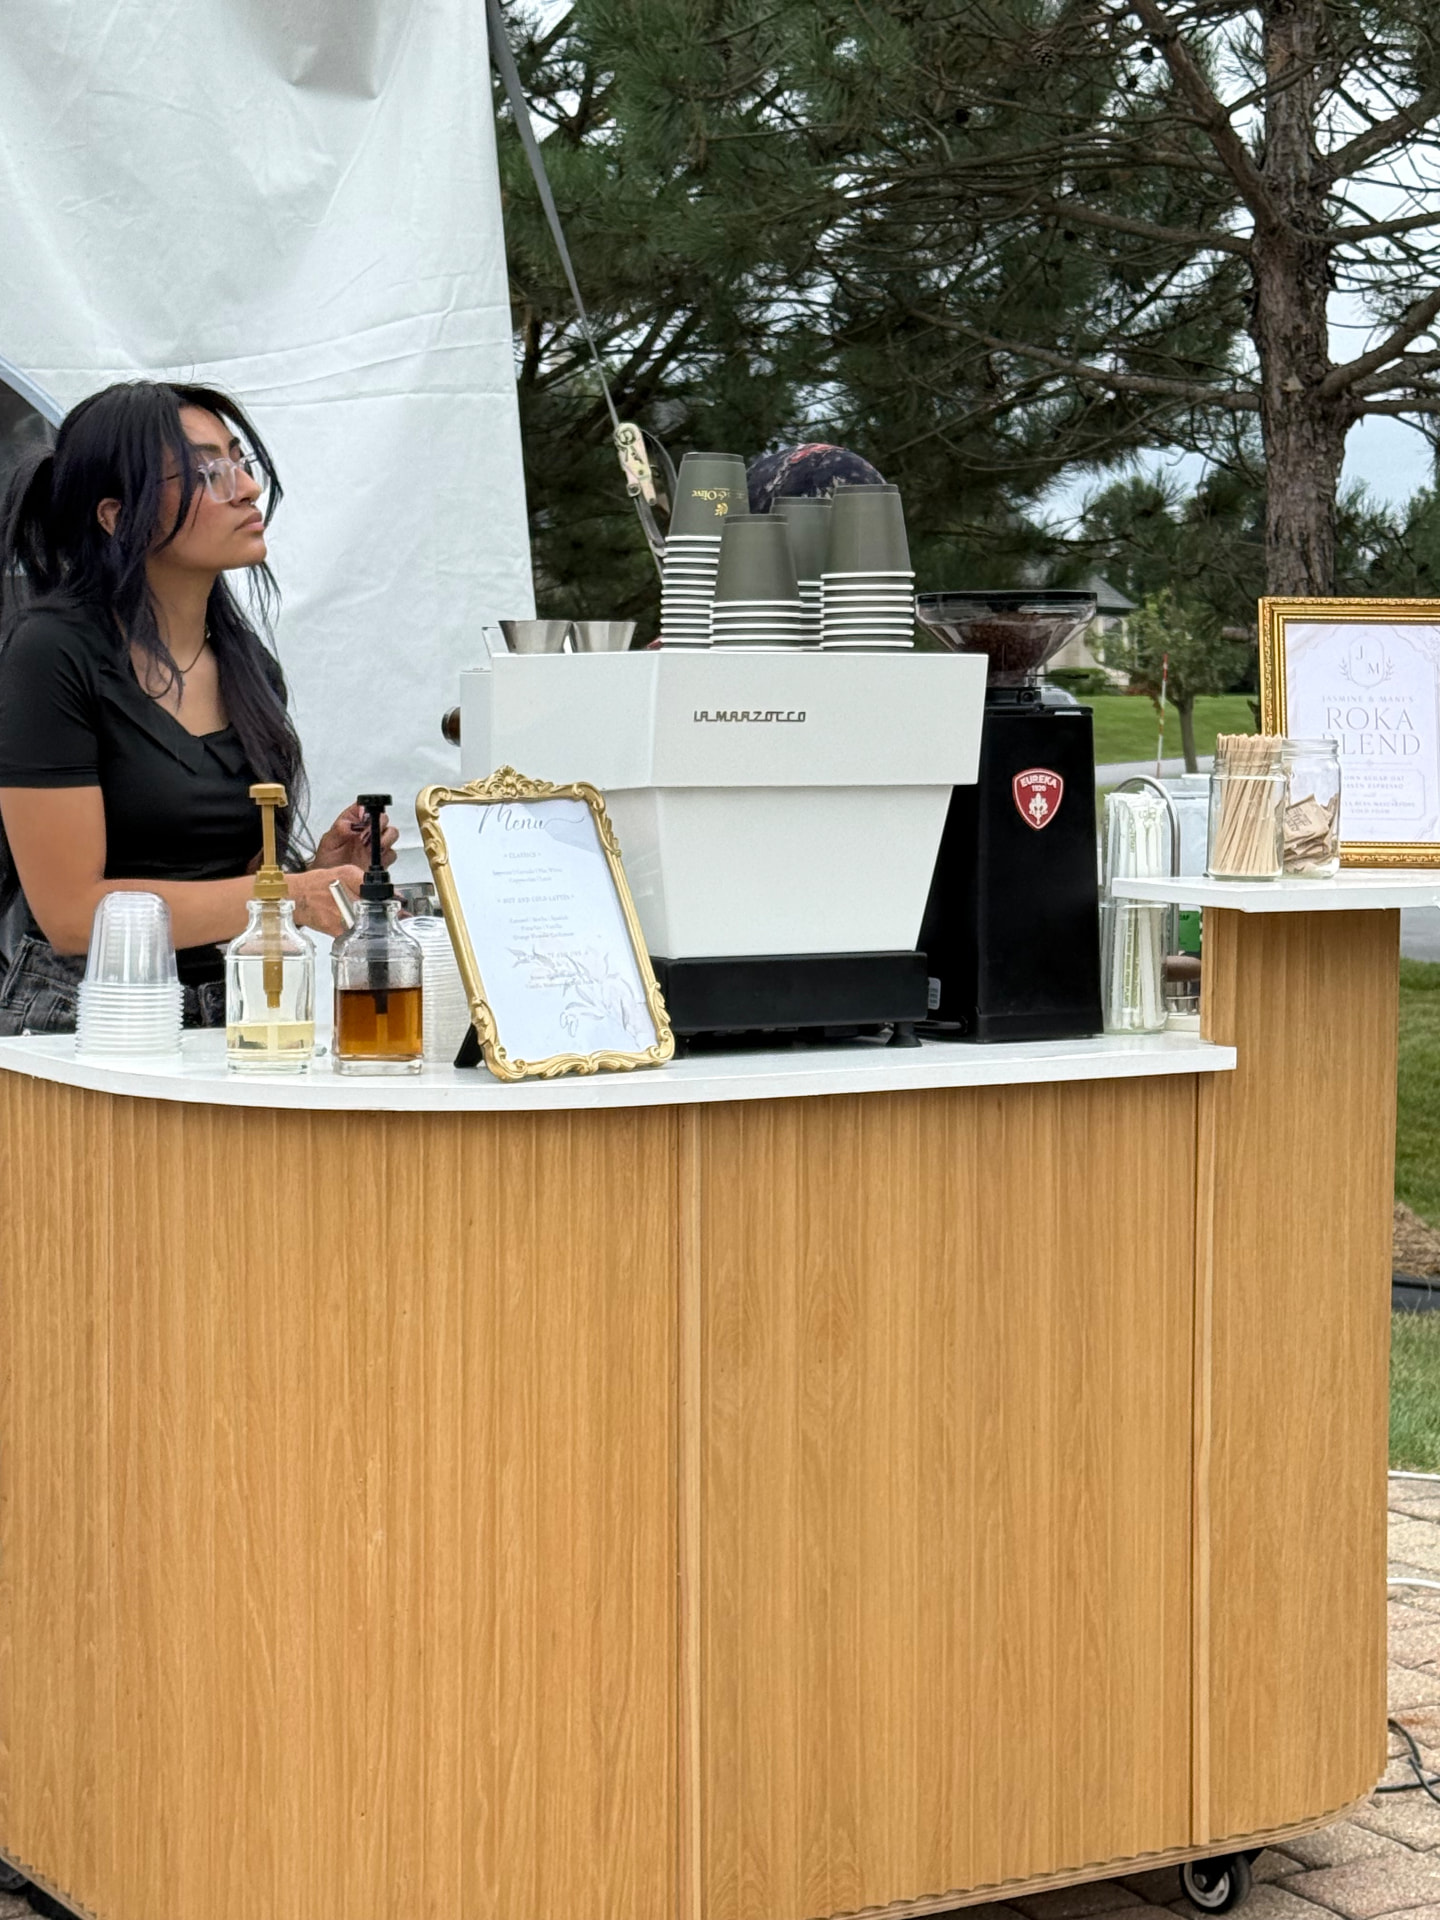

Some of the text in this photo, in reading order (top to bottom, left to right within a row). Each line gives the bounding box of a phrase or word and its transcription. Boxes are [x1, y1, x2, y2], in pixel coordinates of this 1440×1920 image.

[691, 489, 717, 501] Olive
[1368, 662, 1380, 674] M
[1322, 695, 1362, 703] JASMINE
[693, 710, 806, 723] LA MARZOCCO
[1326, 706, 1414, 731] ROKA
[1020, 774, 1057, 789] EUREKA
[478, 802, 585, 834] Menu
